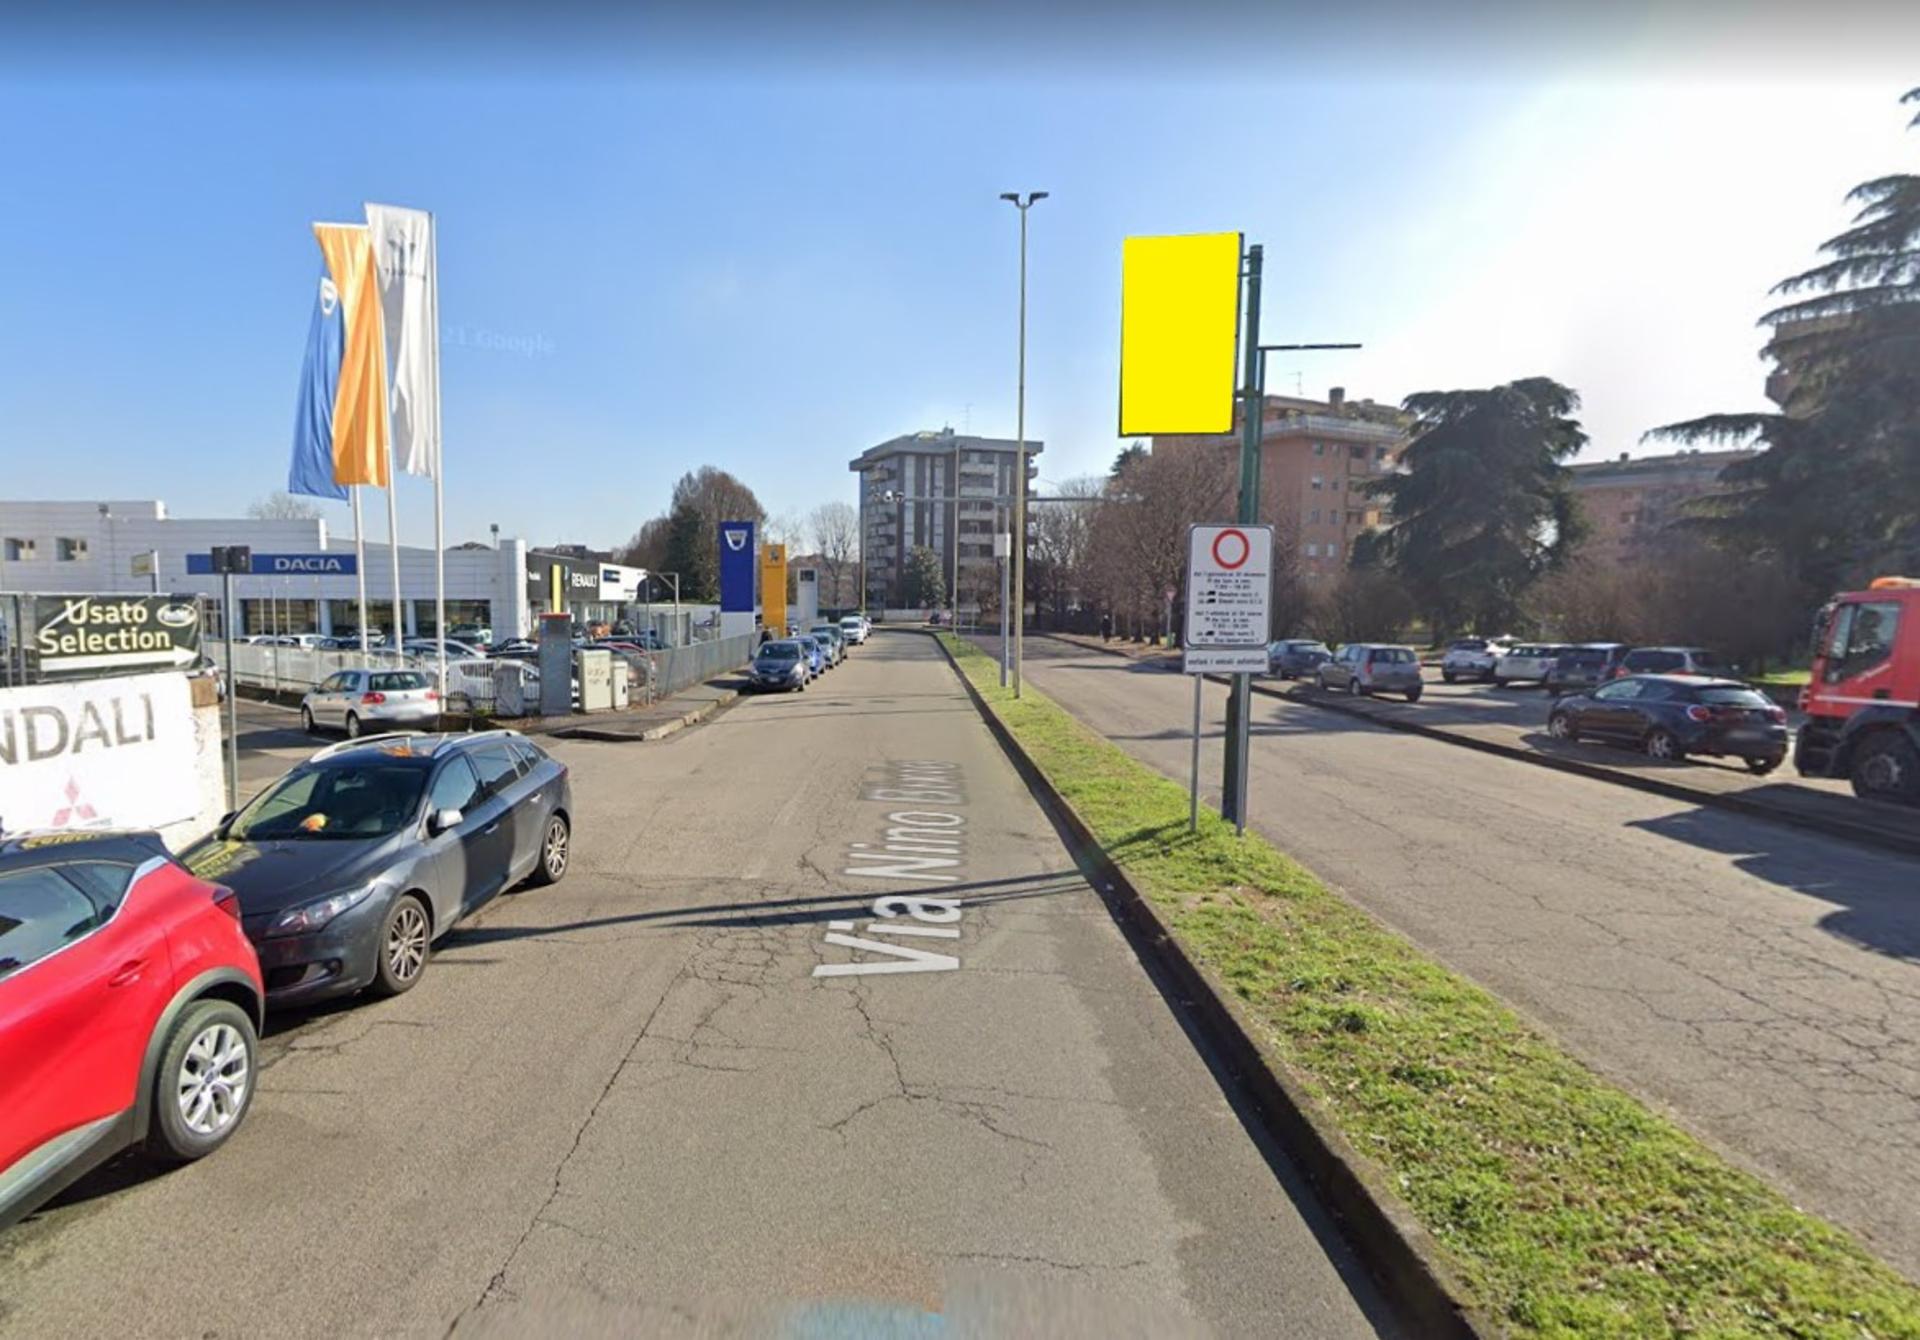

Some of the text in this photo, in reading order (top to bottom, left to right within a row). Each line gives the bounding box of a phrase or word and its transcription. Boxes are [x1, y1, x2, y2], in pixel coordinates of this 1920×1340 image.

[274, 558, 341, 571] DACIA
[65, 599, 148, 625] Usato
[38, 627, 171, 655] Selection
